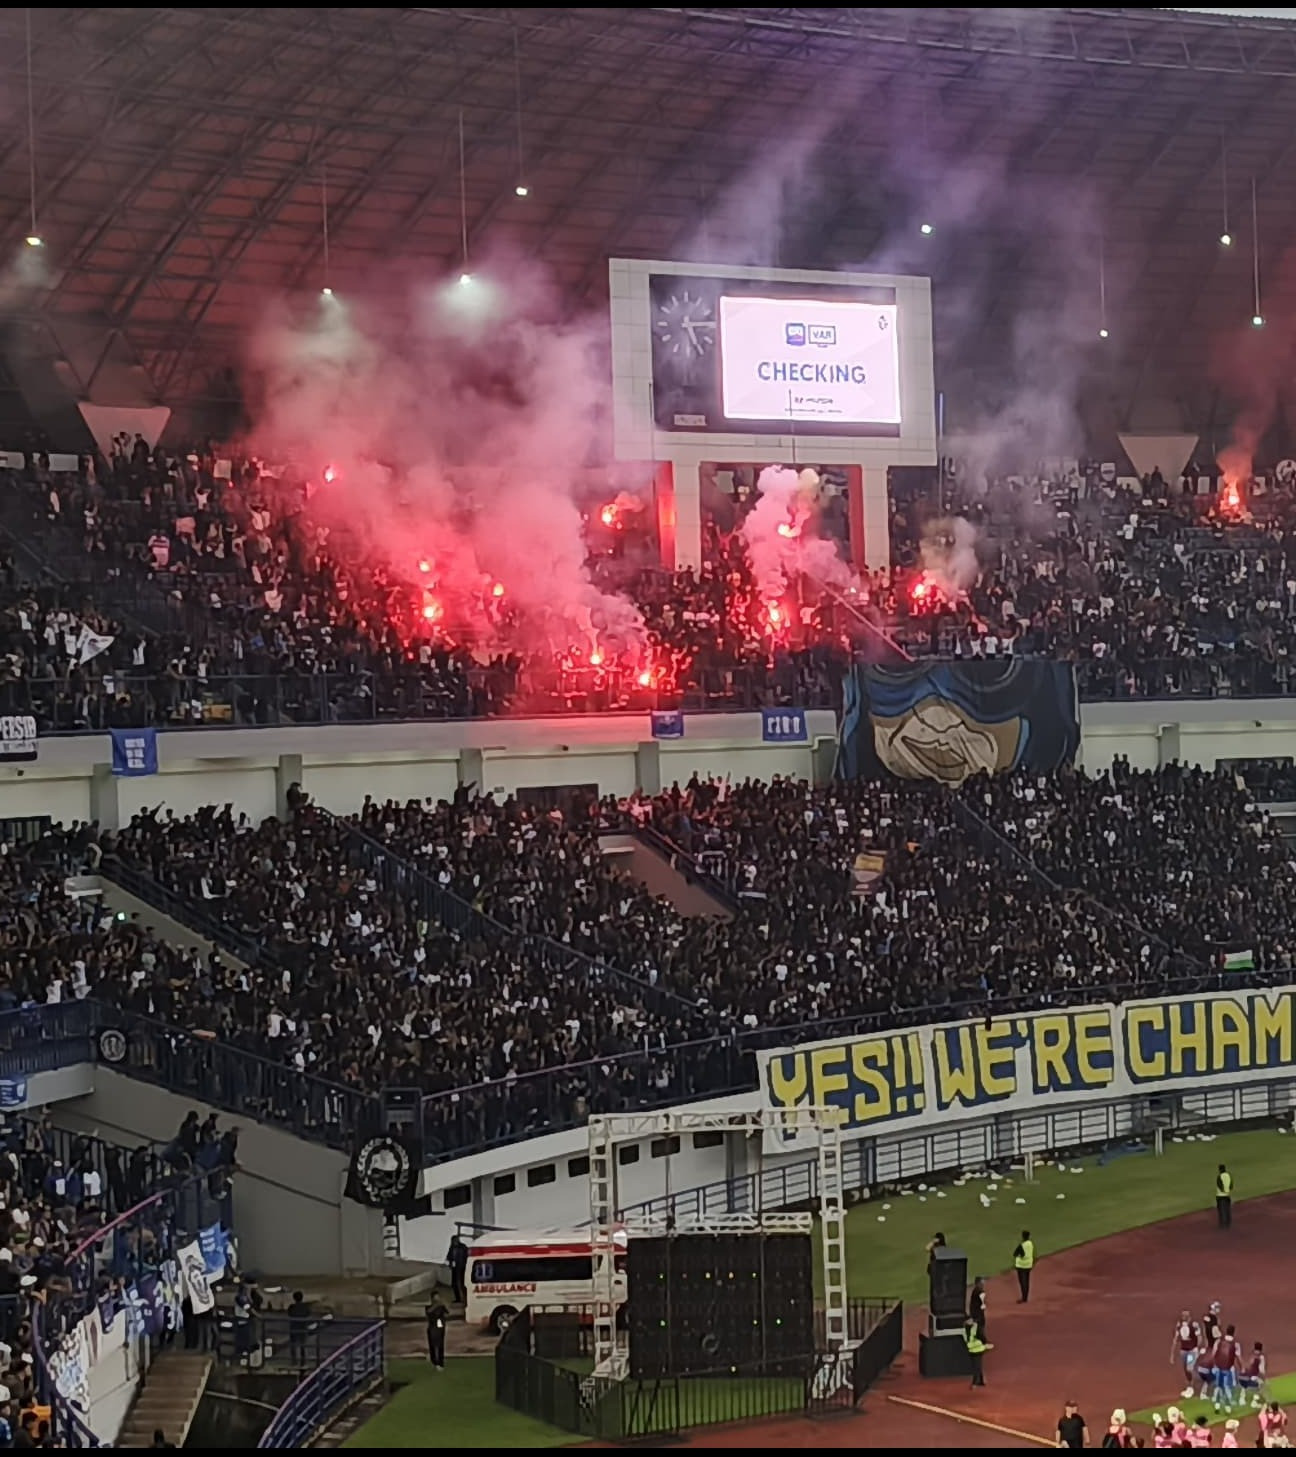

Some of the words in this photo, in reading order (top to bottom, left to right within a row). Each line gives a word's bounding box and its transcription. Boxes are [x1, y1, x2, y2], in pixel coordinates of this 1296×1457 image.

[757, 361, 866, 384] CHECKING
[769, 1032, 926, 1139] YES!!
[934, 1010, 1114, 1111] WE'RE
[473, 1283, 536, 1293] AMBULANCE
